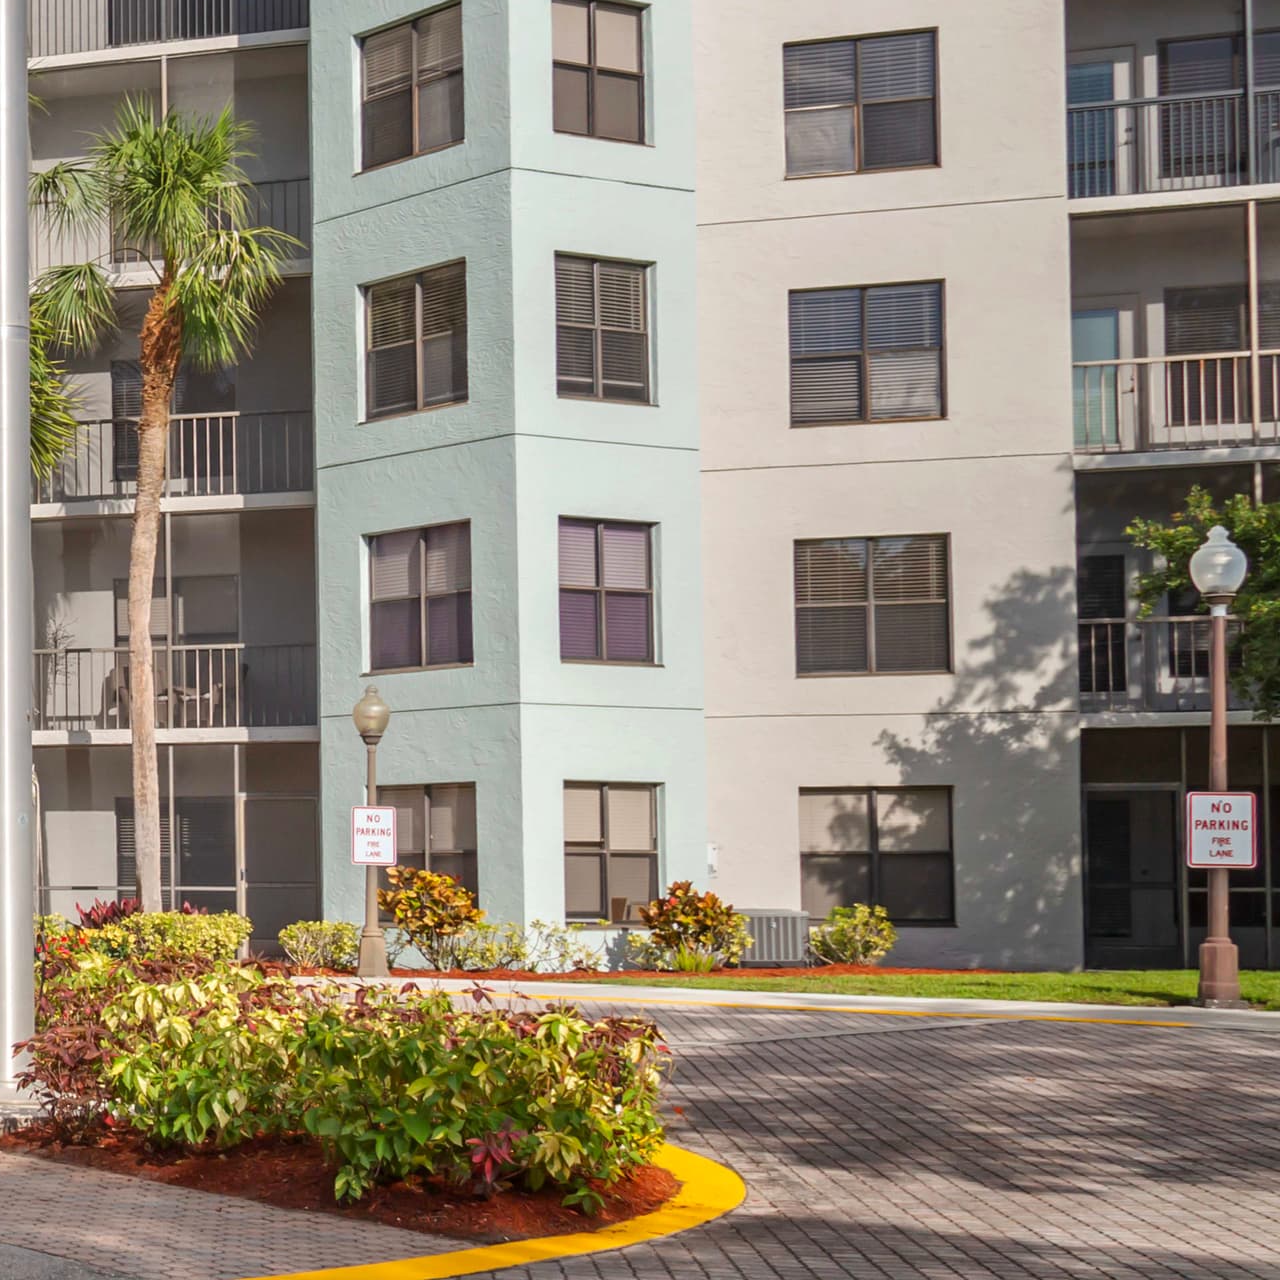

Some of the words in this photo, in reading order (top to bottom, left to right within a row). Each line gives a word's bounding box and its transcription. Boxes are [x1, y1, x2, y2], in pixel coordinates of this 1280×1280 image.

[1211, 802, 1233, 814] NO
[366, 814, 381, 823] NO
[1194, 819, 1249, 831] PARKING
[356, 827, 392, 837] PARKING
[1211, 836, 1232, 846] FIRE
[1208, 849, 1234, 858] LANE
